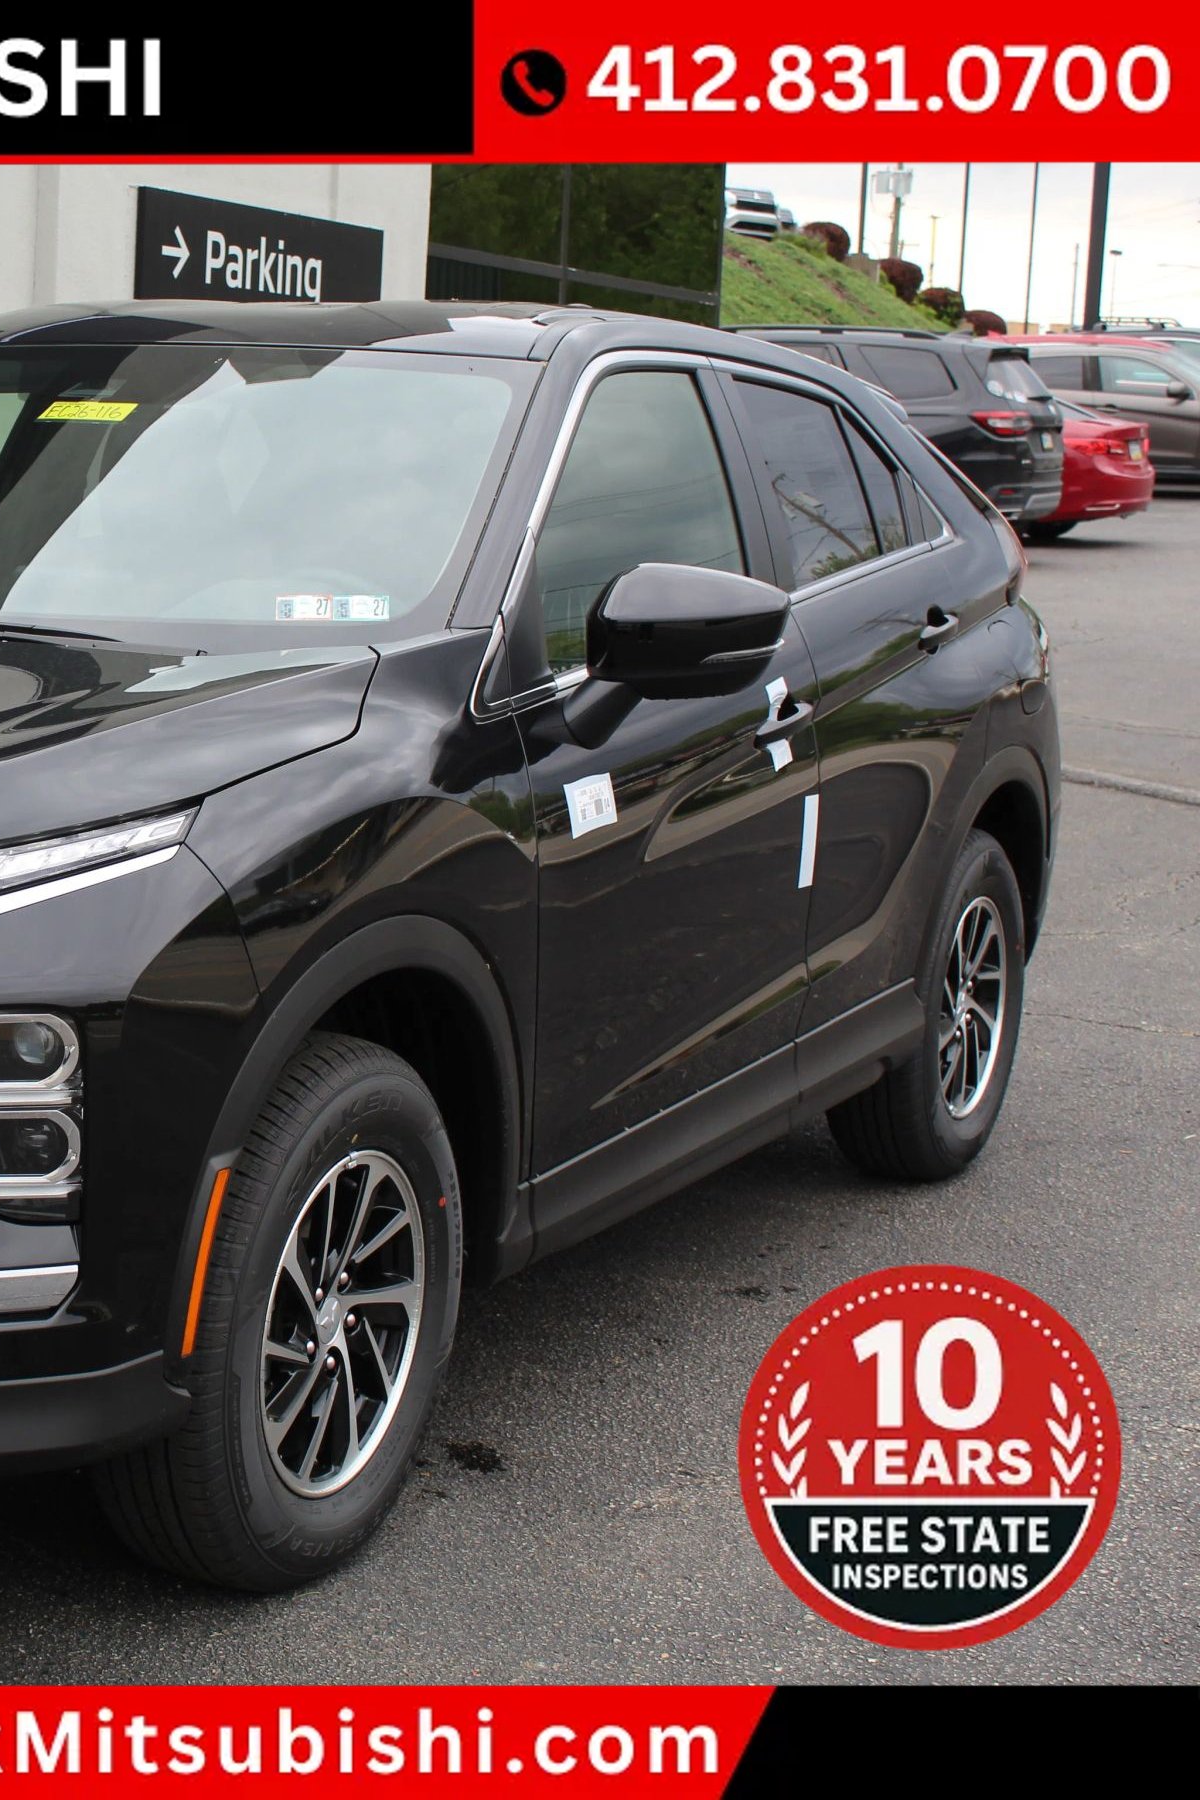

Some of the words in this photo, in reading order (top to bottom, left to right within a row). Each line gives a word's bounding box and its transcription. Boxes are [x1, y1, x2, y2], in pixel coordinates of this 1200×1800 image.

[205, 230, 322, 303] Parking
[316, 599, 328, 615] 27
[374, 599, 385, 616] 27
